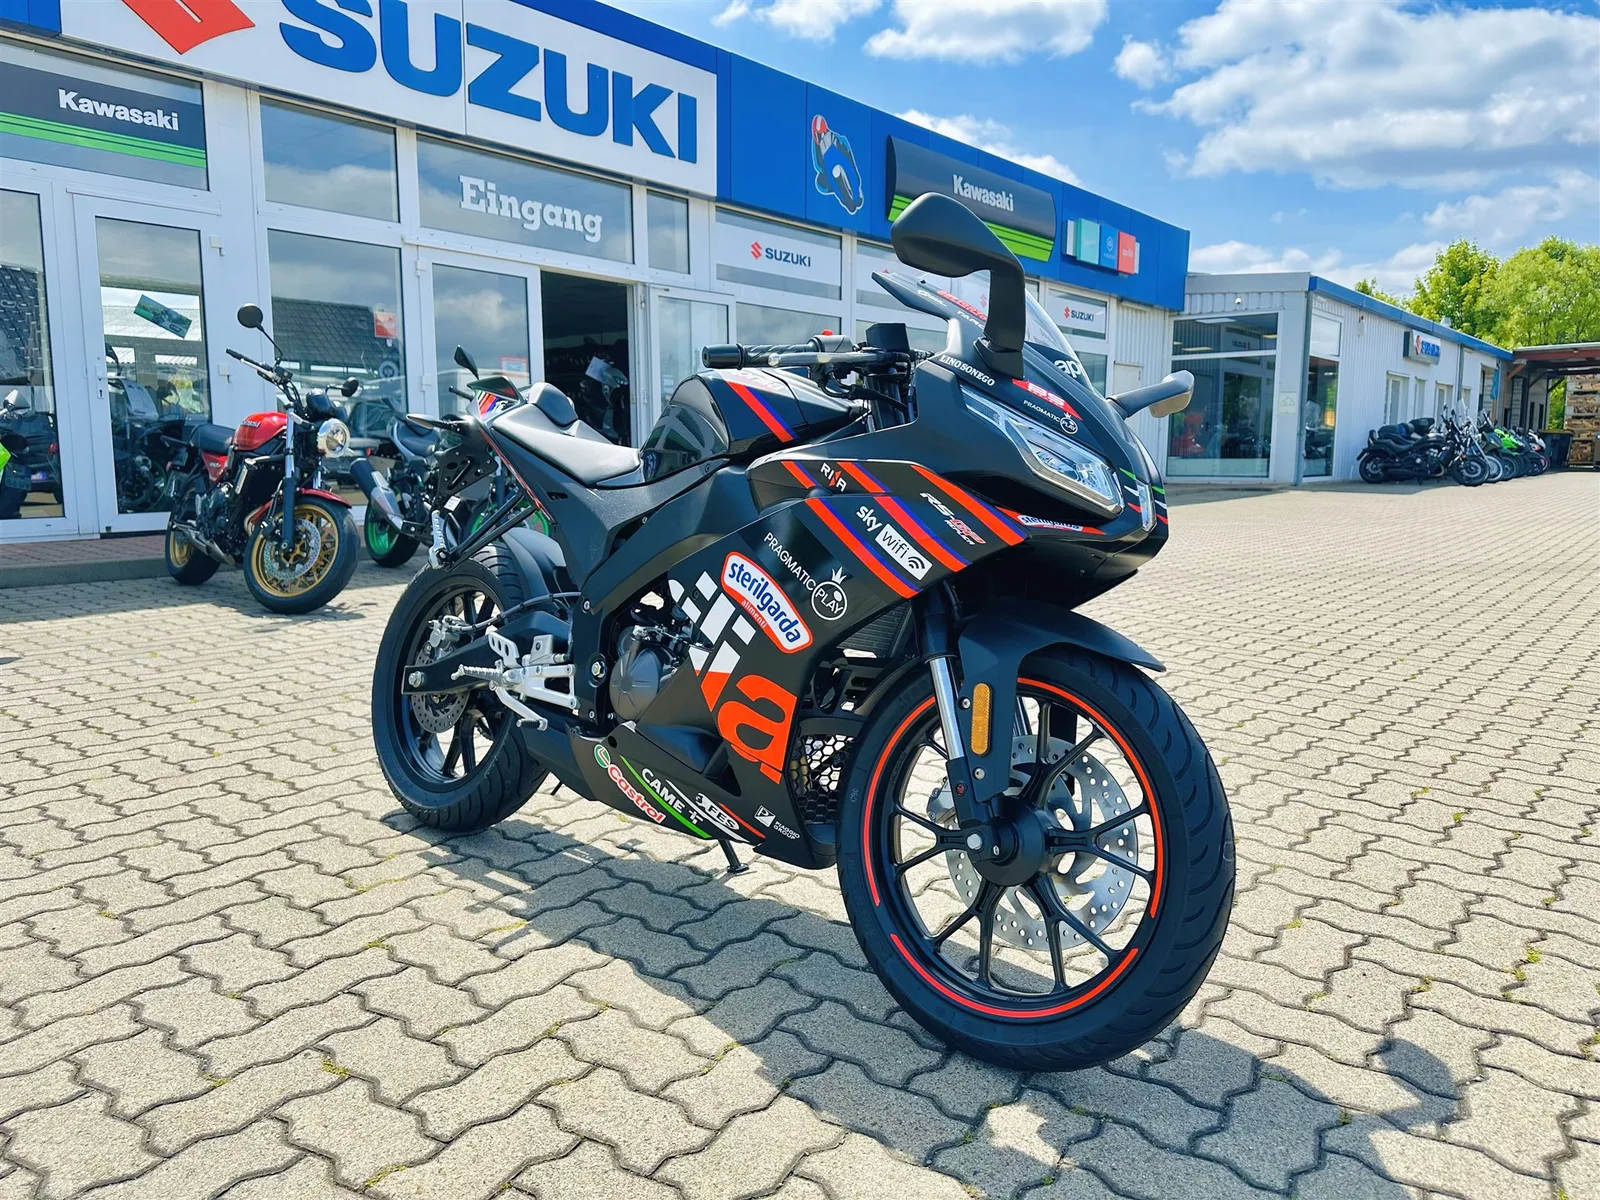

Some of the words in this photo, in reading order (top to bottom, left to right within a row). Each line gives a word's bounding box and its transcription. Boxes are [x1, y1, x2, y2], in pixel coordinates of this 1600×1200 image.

[279, 0, 697, 164] SUZUKI
[58, 88, 180, 132] Kawasaki
[458, 174, 603, 243] Eingang
[952, 174, 1014, 212] Kawasaki
[764, 247, 812, 267] SUZUKI
[1070, 309, 1094, 322] SUZUKI
[939, 354, 961, 370] LINO
[960, 363, 996, 387] SONEGO
[1023, 399, 1061, 423] PRAGMATIC
[856, 505, 883, 532] sky
[881, 531, 910, 559] wifi
[763, 531, 817, 591] PRAGMATIC
[815, 588, 844, 614] PLAY
[728, 562, 801, 643] sterilgarda
[741, 599, 768, 630] alimenti
[607, 763, 667, 824] Castrol
[641, 767, 686, 814] CAME
